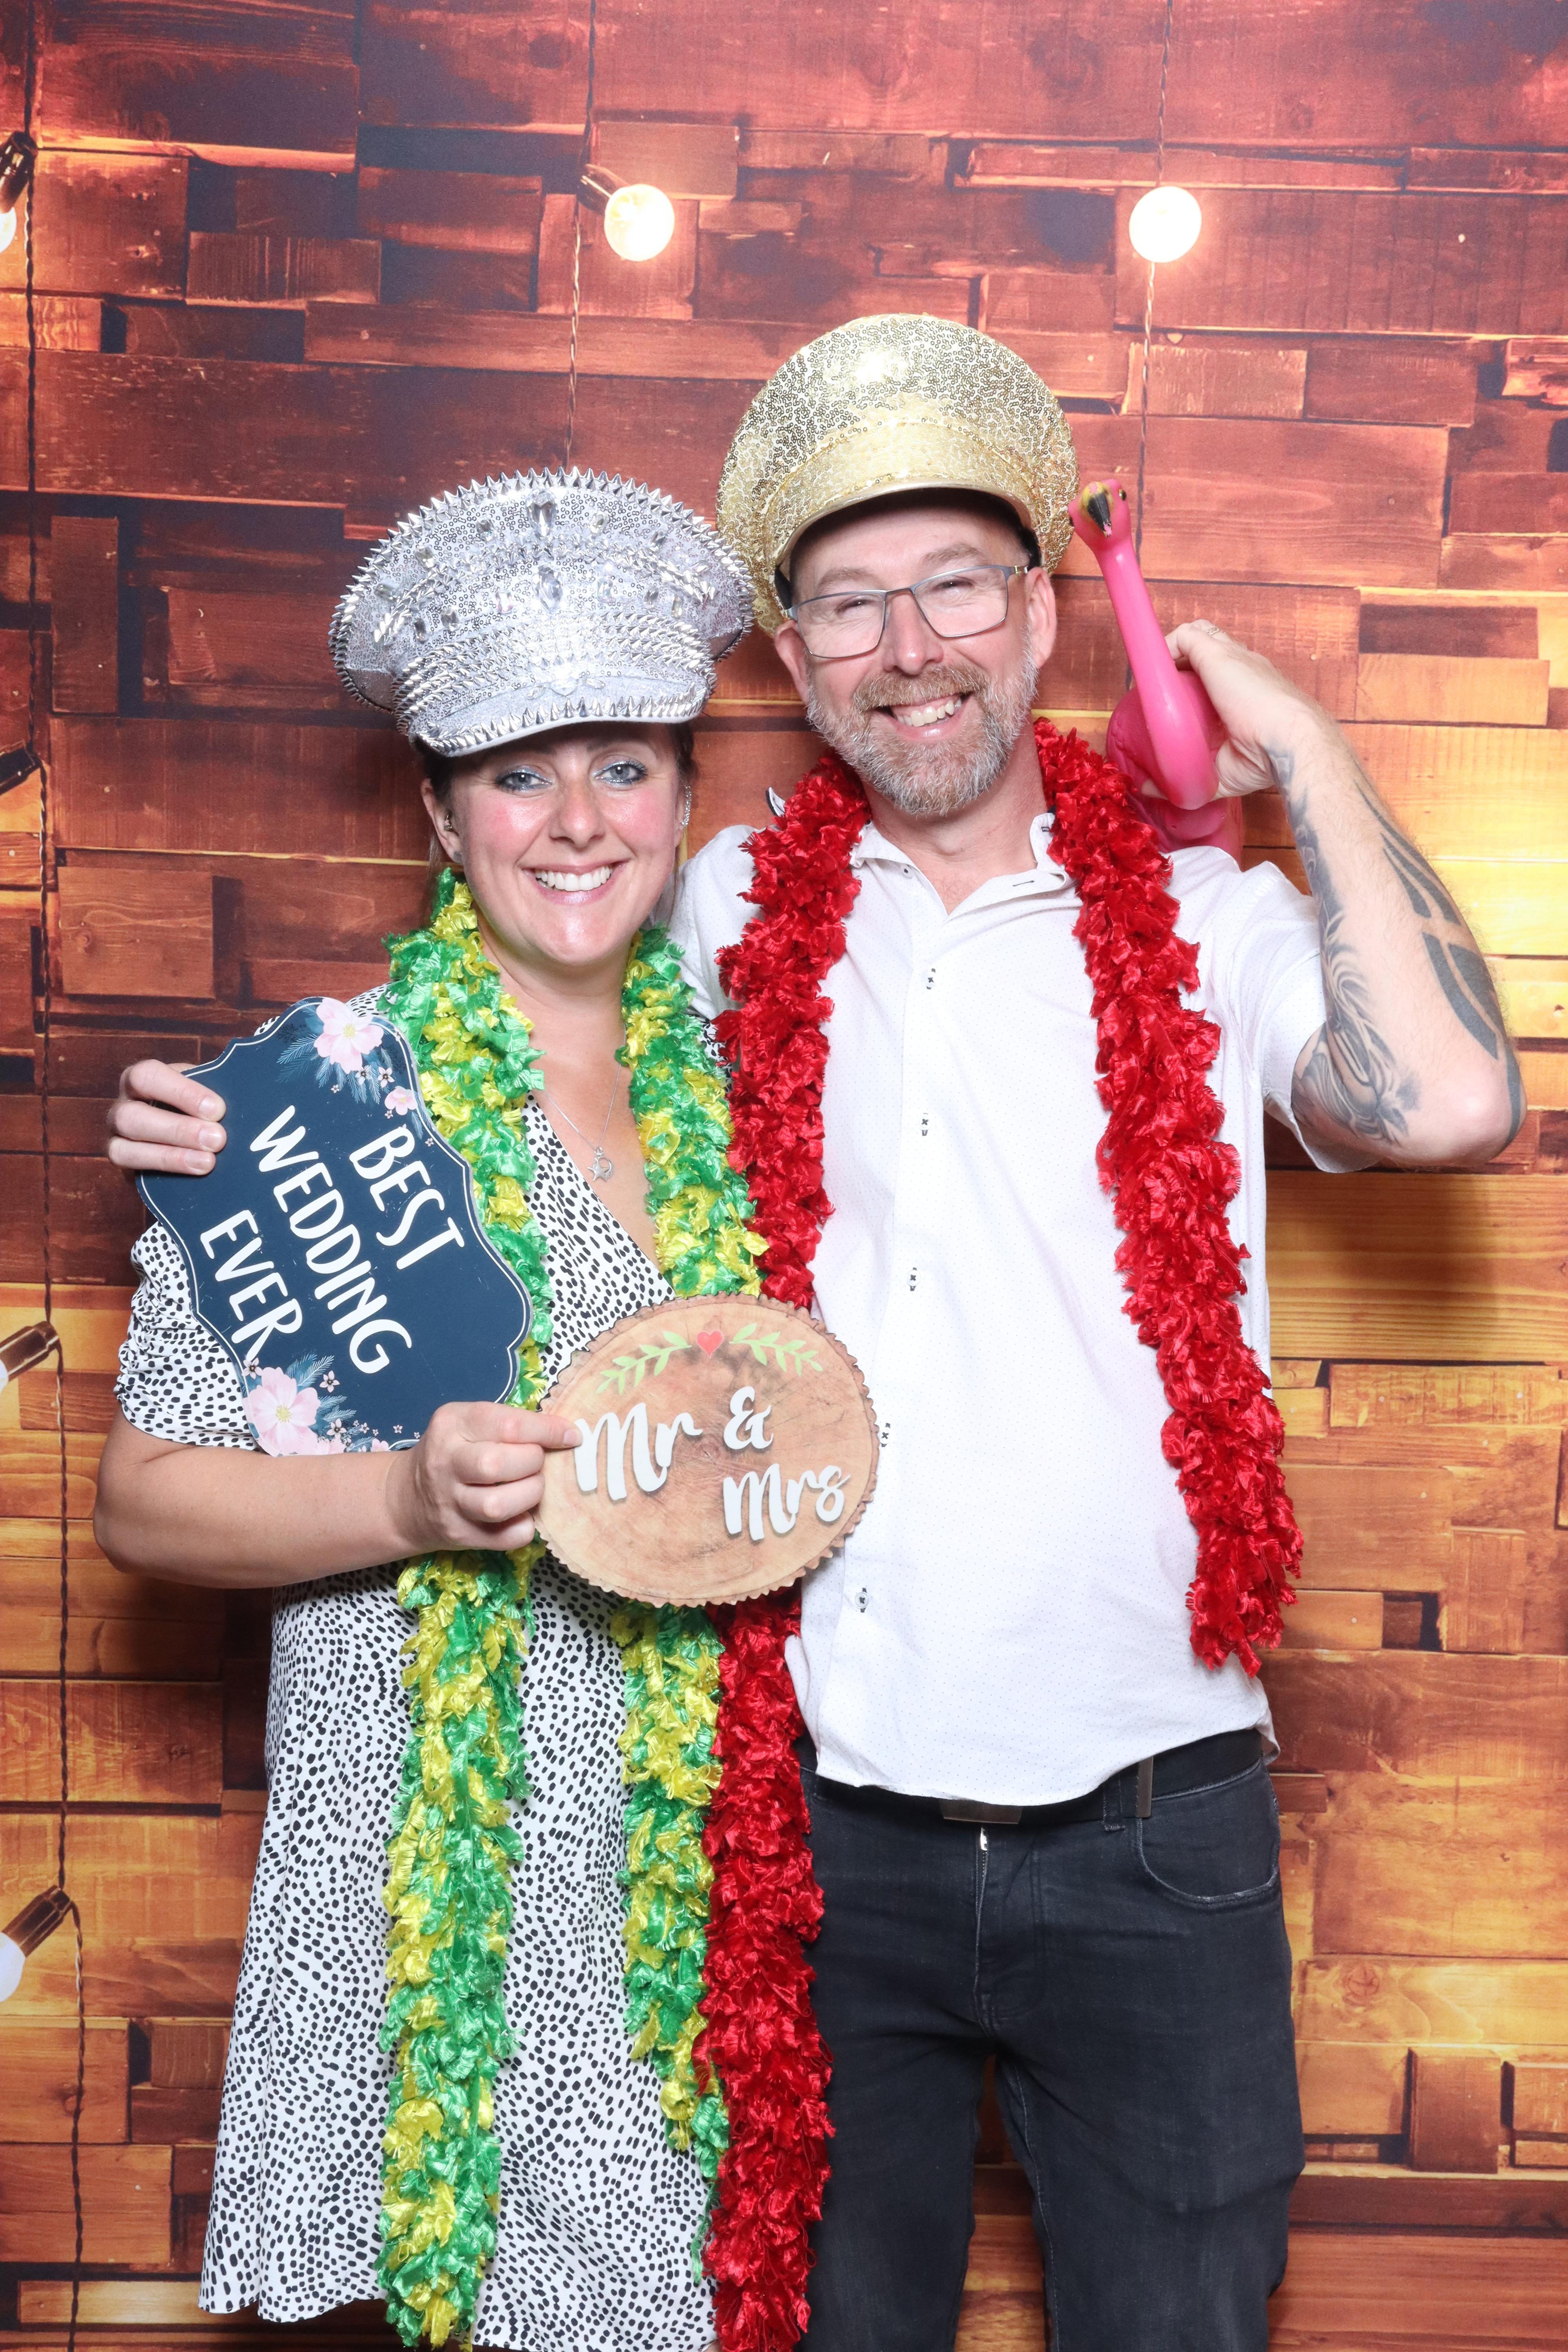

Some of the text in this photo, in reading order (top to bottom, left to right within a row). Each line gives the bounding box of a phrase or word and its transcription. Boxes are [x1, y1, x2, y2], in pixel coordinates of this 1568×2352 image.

[249, 1105, 412, 1374] WEDDING
[348, 1123, 465, 1270] BEST
[200, 1209, 303, 1359] EVER
[573, 1385, 774, 1501] Mr &
[723, 1462, 851, 1541] Mrs
